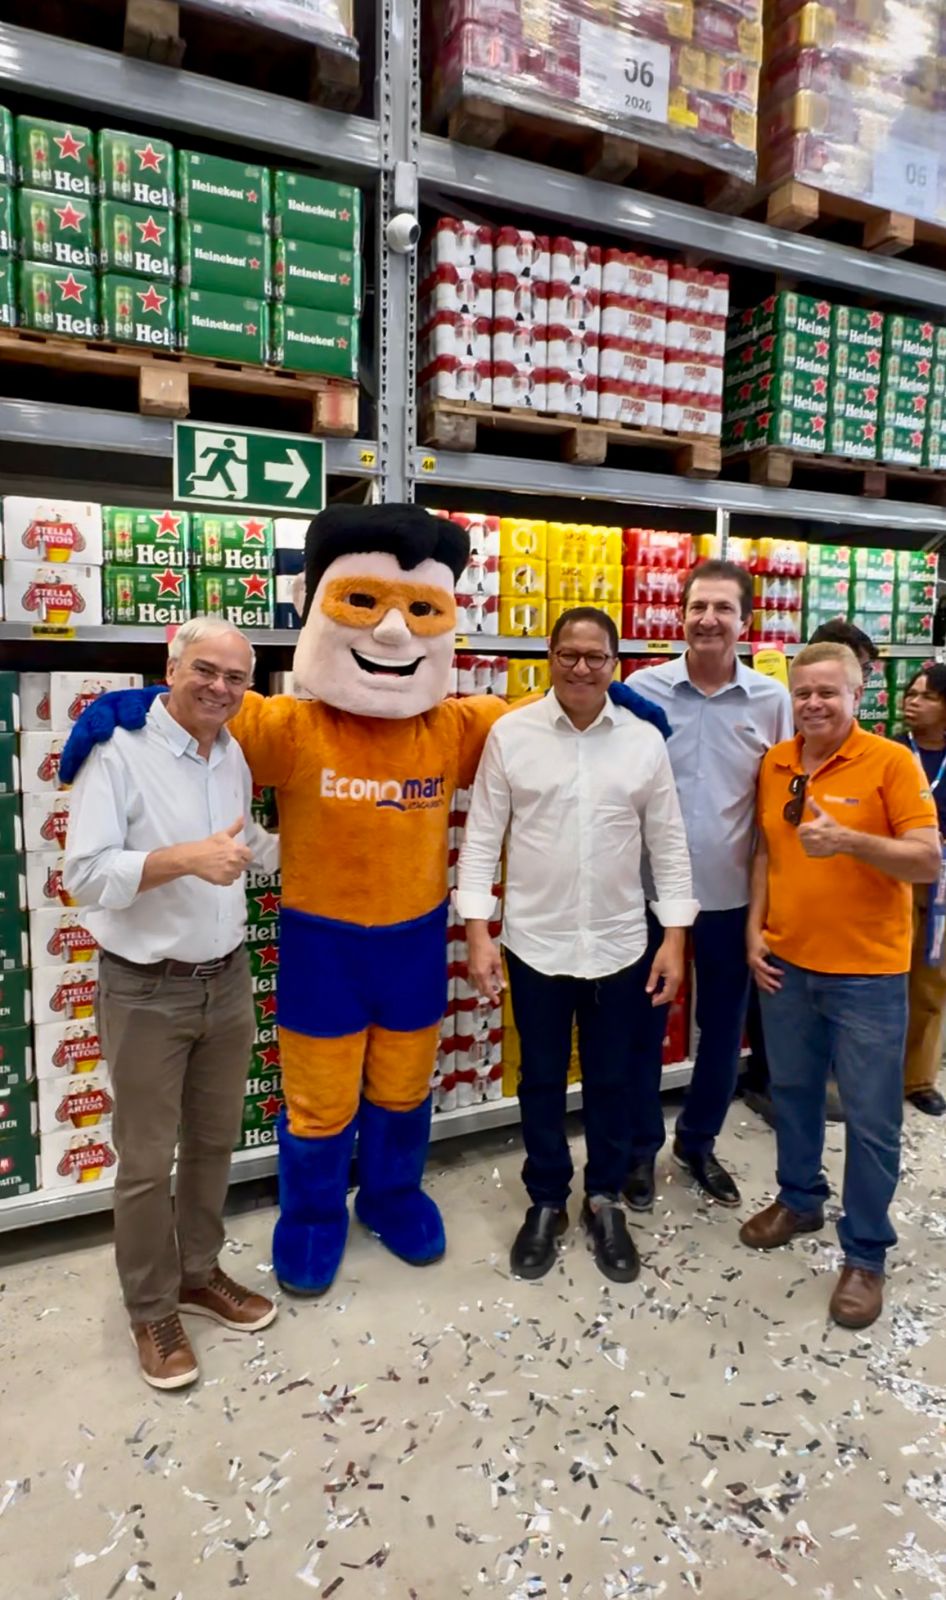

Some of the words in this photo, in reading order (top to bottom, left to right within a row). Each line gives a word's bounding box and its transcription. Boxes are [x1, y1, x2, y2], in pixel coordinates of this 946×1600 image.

[624, 58, 654, 88] 06
[625, 94, 652, 113] 2026
[192, 179, 243, 200] Heineken
[288, 199, 337, 219] Heineken
[195, 247, 246, 267] Heineken
[289, 265, 337, 283] Heineken
[192, 315, 243, 333] Heineken
[287, 330, 335, 347] Heineken
[34, 526, 73, 537] STELLA
[34, 588, 73, 598] STELLA
[320, 767, 445, 801] Economart
[64, 1041, 100, 1053] STELLA
[67, 1095, 103, 1107] STELLA
[67, 1102, 103, 1114] ARTOIS
[69, 1149, 104, 1161] STELLA
